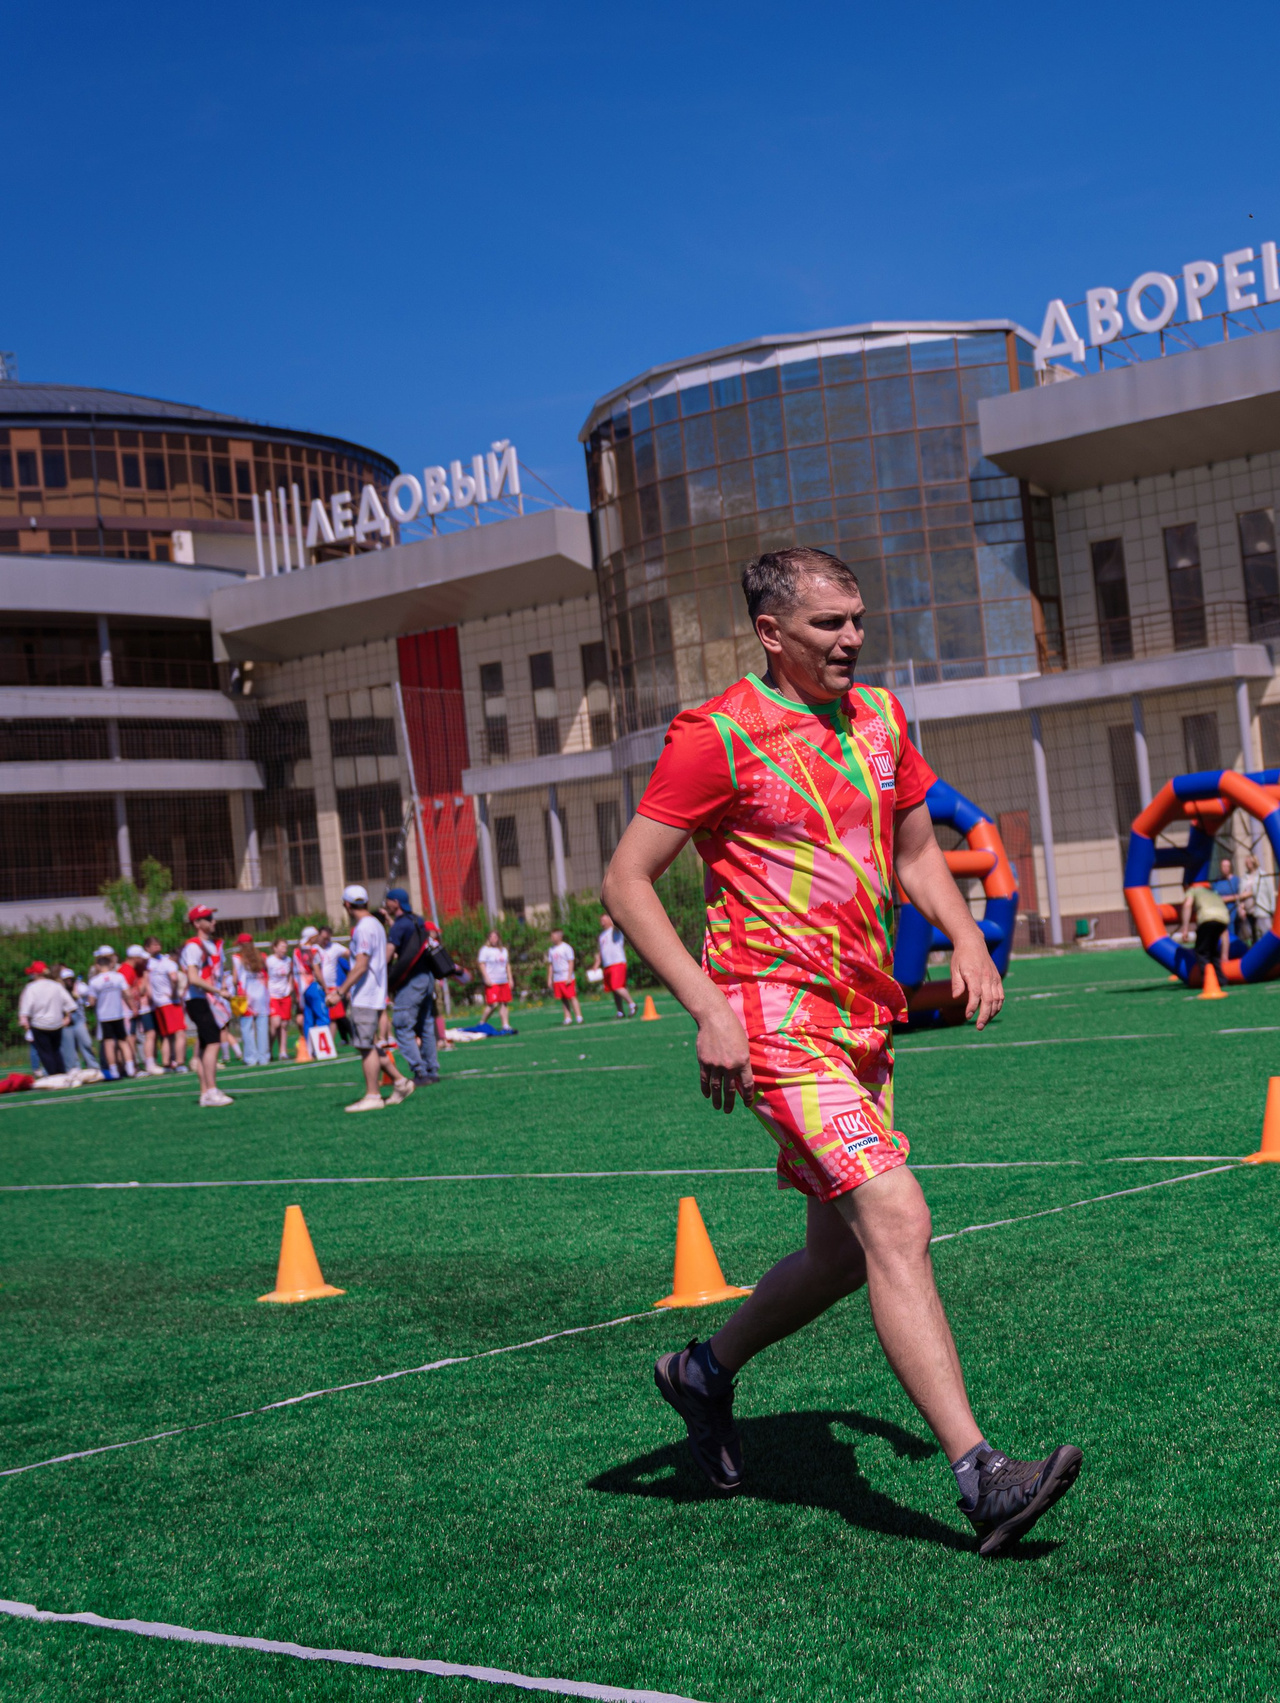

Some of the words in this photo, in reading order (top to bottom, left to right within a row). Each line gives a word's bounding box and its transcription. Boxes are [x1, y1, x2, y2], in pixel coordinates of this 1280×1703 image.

[305, 438, 521, 548] ЛЕДОВЫЙ
[319, 1032, 331, 1054] 4
[847, 1136, 878, 1152] ЛУКОЙЛ
